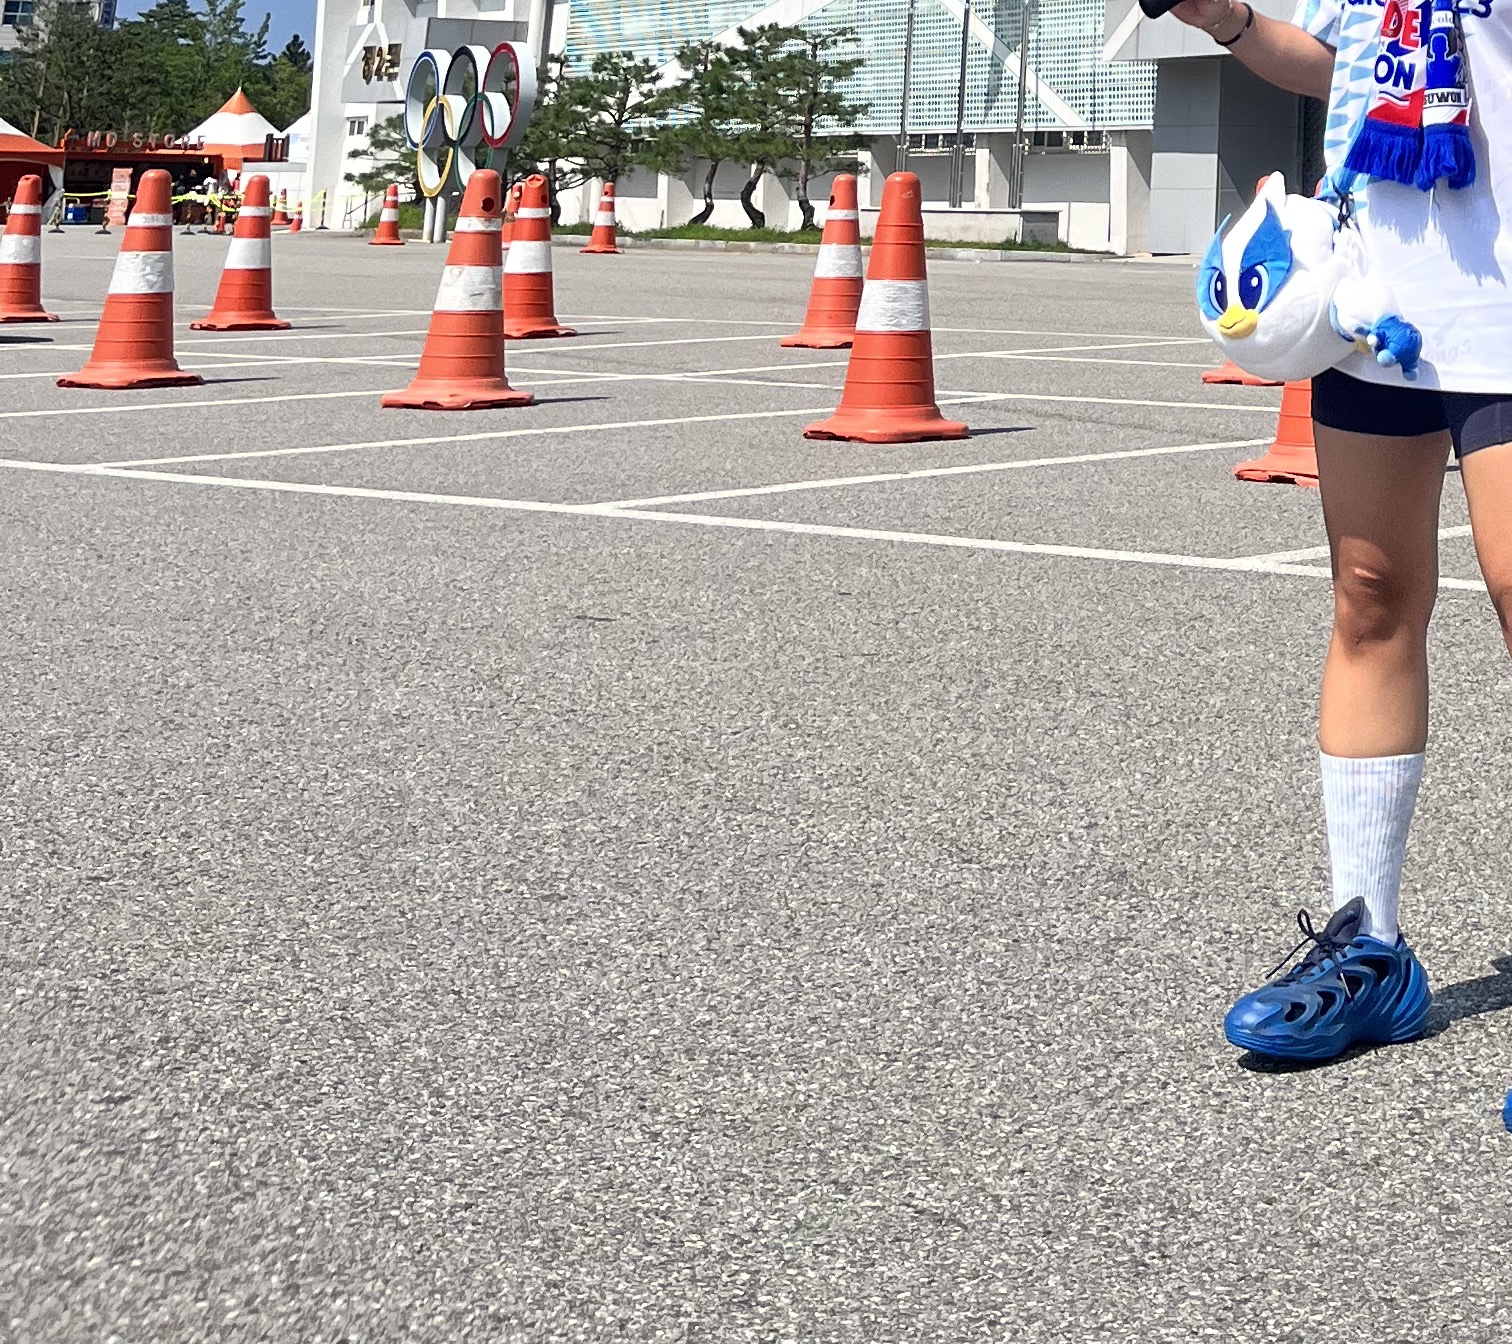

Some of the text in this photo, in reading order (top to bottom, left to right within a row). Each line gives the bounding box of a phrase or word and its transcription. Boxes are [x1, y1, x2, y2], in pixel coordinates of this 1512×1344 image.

[1381, 0, 1421, 49] DE
[1374, 53, 1417, 90] ON
[86, 130, 206, 150] MD STORE
